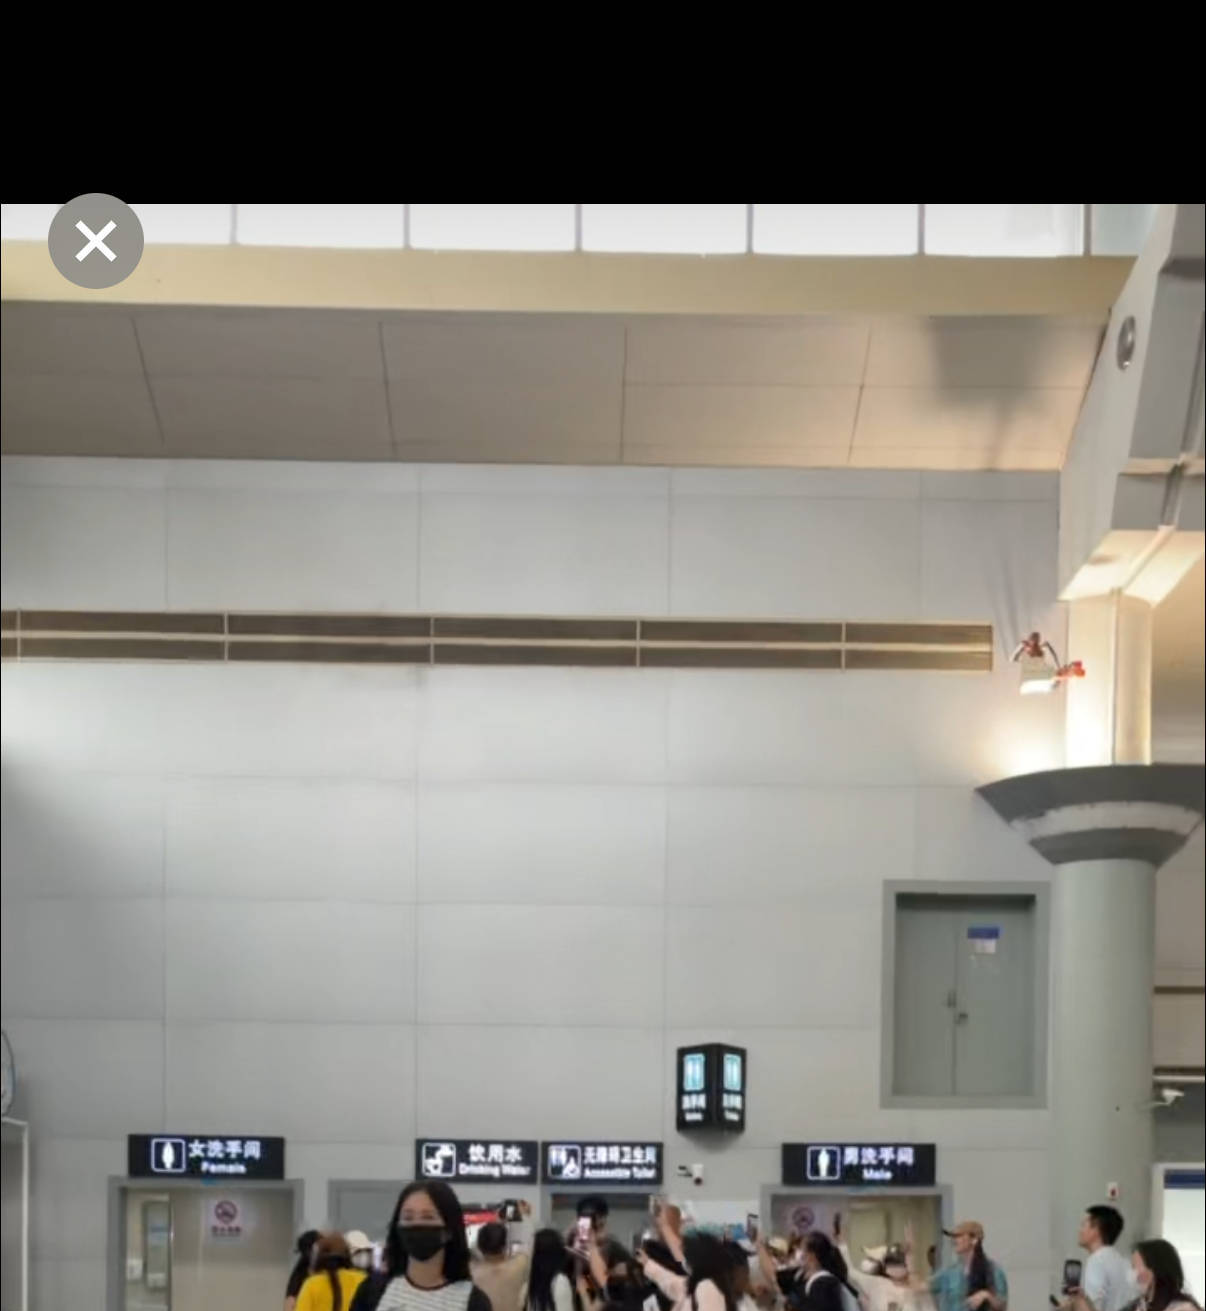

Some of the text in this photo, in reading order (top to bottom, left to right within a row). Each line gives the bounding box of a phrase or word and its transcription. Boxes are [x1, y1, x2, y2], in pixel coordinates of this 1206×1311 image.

[188, 1140, 261, 1159] 女洗手间
[468, 1144, 522, 1163] 饮用水
[843, 1147, 914, 1166] 男洗手间
[862, 1168, 893, 1180] Male
